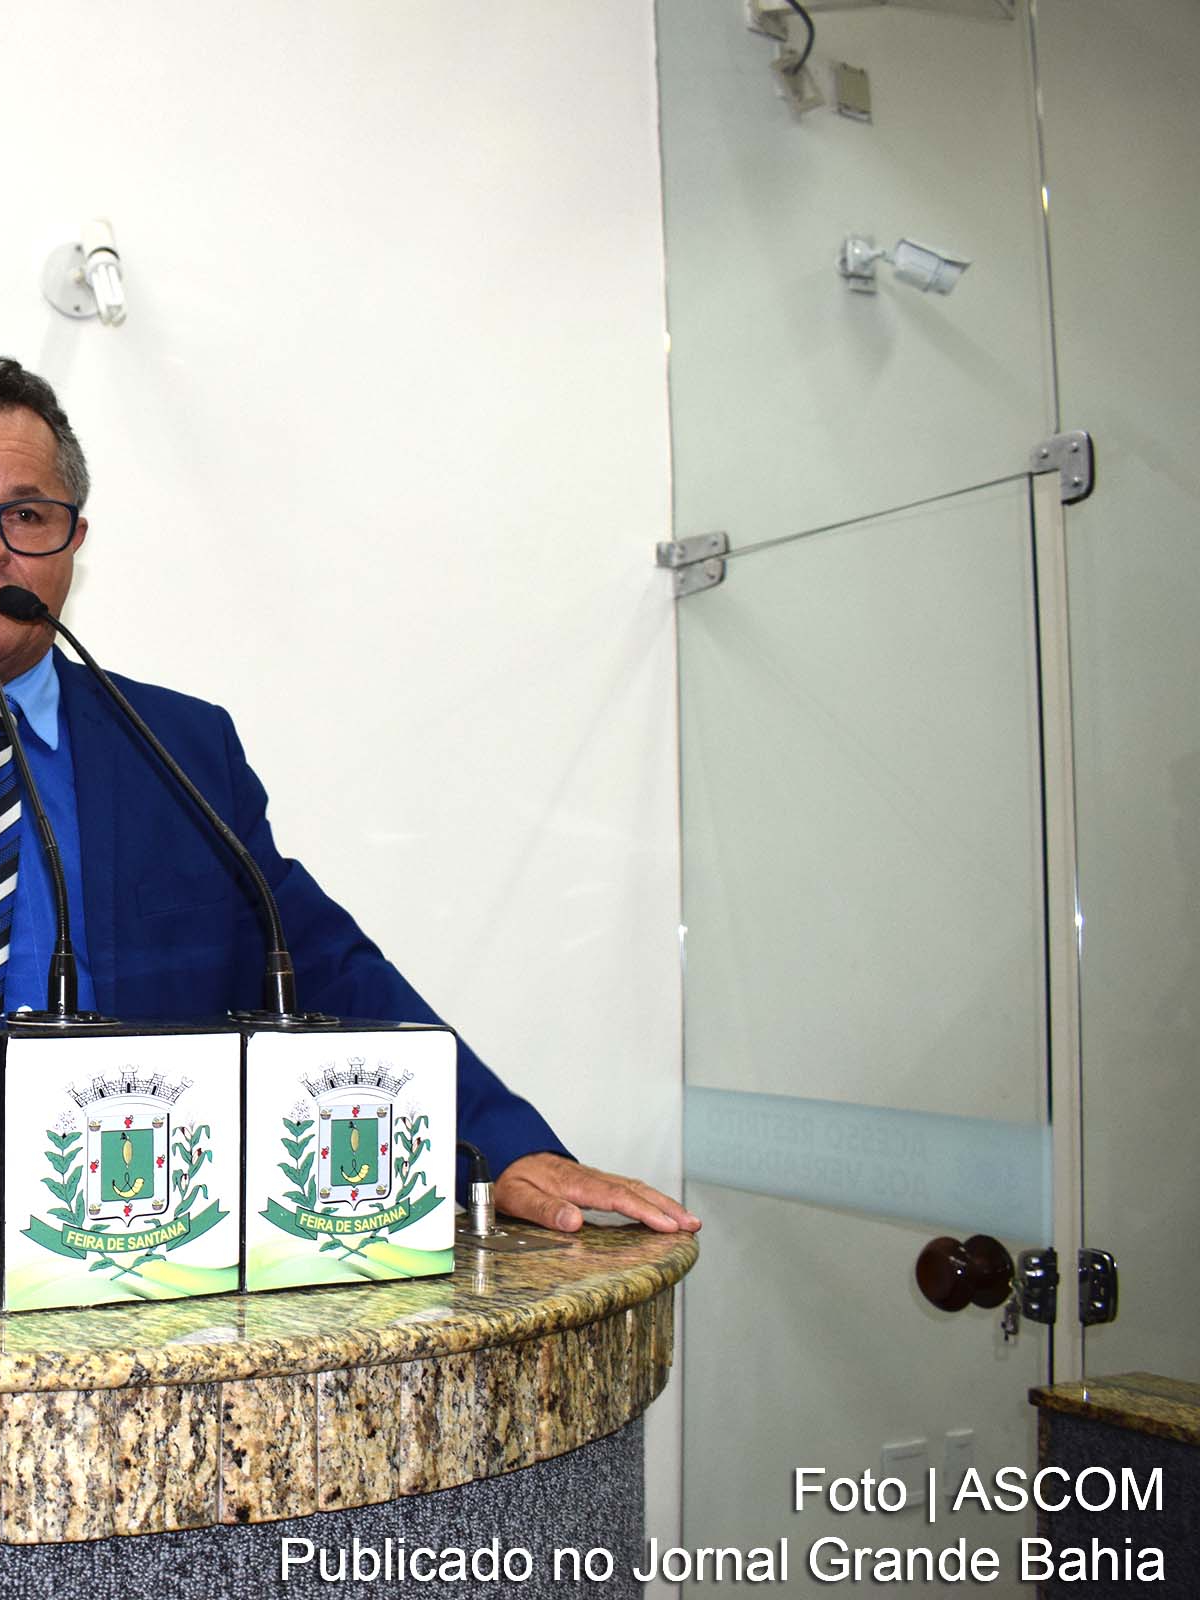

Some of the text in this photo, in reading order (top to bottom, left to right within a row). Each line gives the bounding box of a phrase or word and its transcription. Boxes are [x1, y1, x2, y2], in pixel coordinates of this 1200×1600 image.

[299, 1206, 407, 1232] FEIRA DE SANTANA
[66, 1221, 187, 1251] FEIRA DE SANTANA
